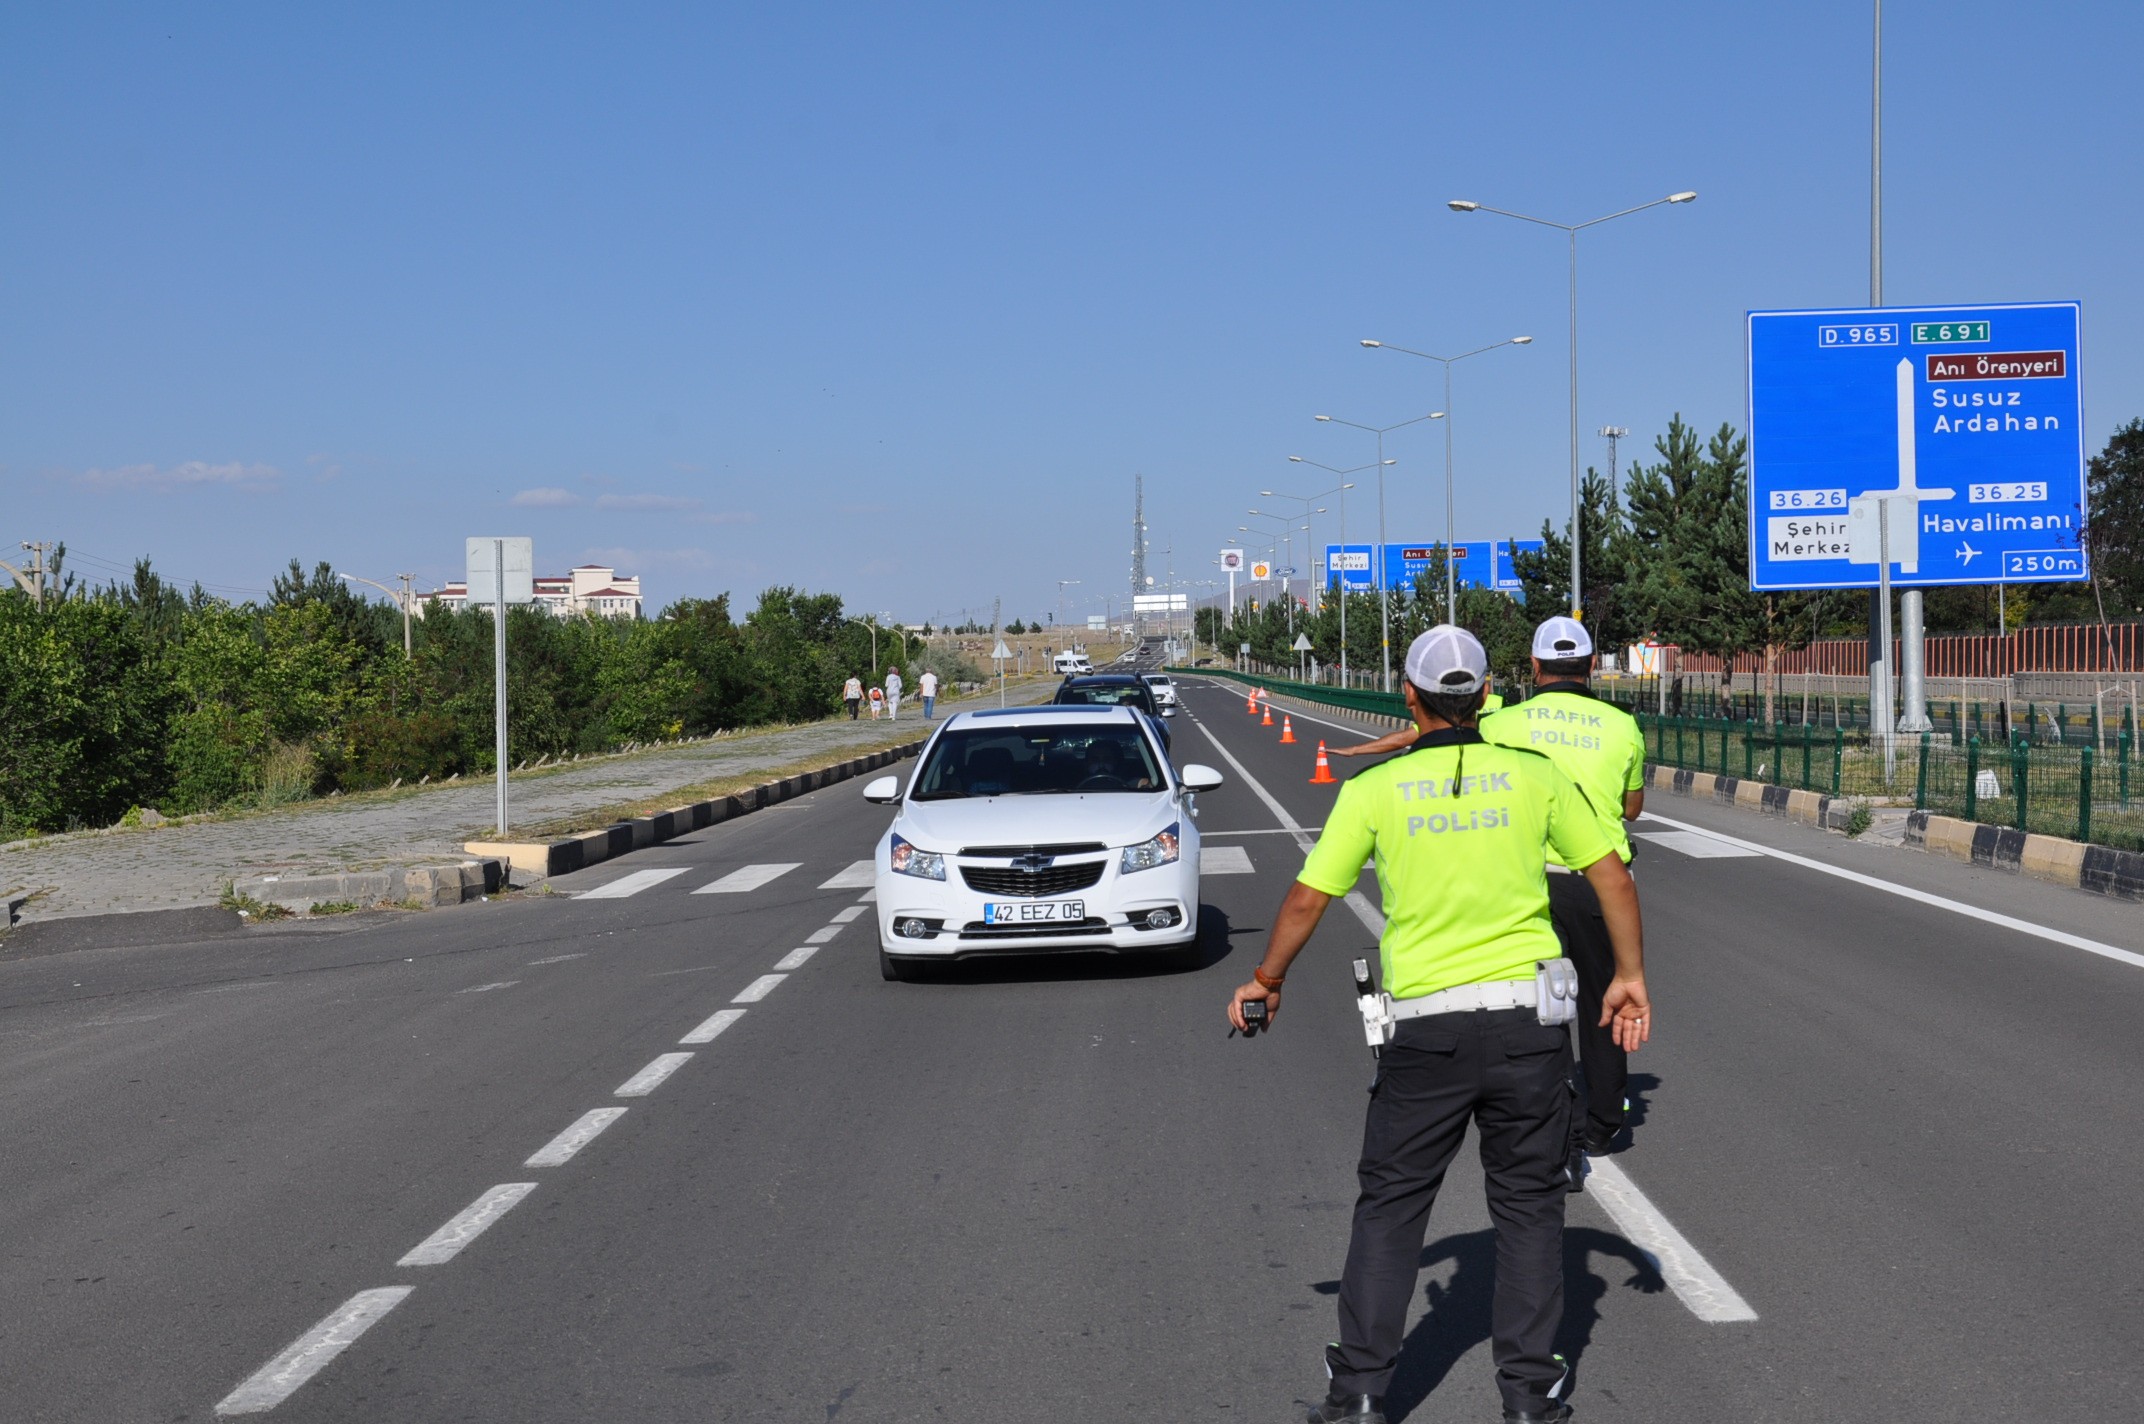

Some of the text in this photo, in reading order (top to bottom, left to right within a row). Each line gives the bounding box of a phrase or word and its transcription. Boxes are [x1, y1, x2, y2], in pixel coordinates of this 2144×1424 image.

[1825, 328, 1891, 344] D.965
[1917, 325, 1985, 341] E.691
[1933, 357, 2058, 377] Anı Örenyeri
[1932, 389, 2021, 408] Susuz
[1933, 413, 2059, 434] Ardahan
[1775, 491, 1842, 507] 36.26
[1974, 485, 2042, 500] 36.25
[1787, 521, 1847, 539] Şehir
[1923, 512, 2071, 533] Havalimanı
[1774, 540, 1850, 556] Merkez
[2011, 556, 2077, 572] 250m
[994, 905, 1013, 921] 42
[1021, 904, 1055, 920] EEZ
[1062, 903, 1081, 919] 05
